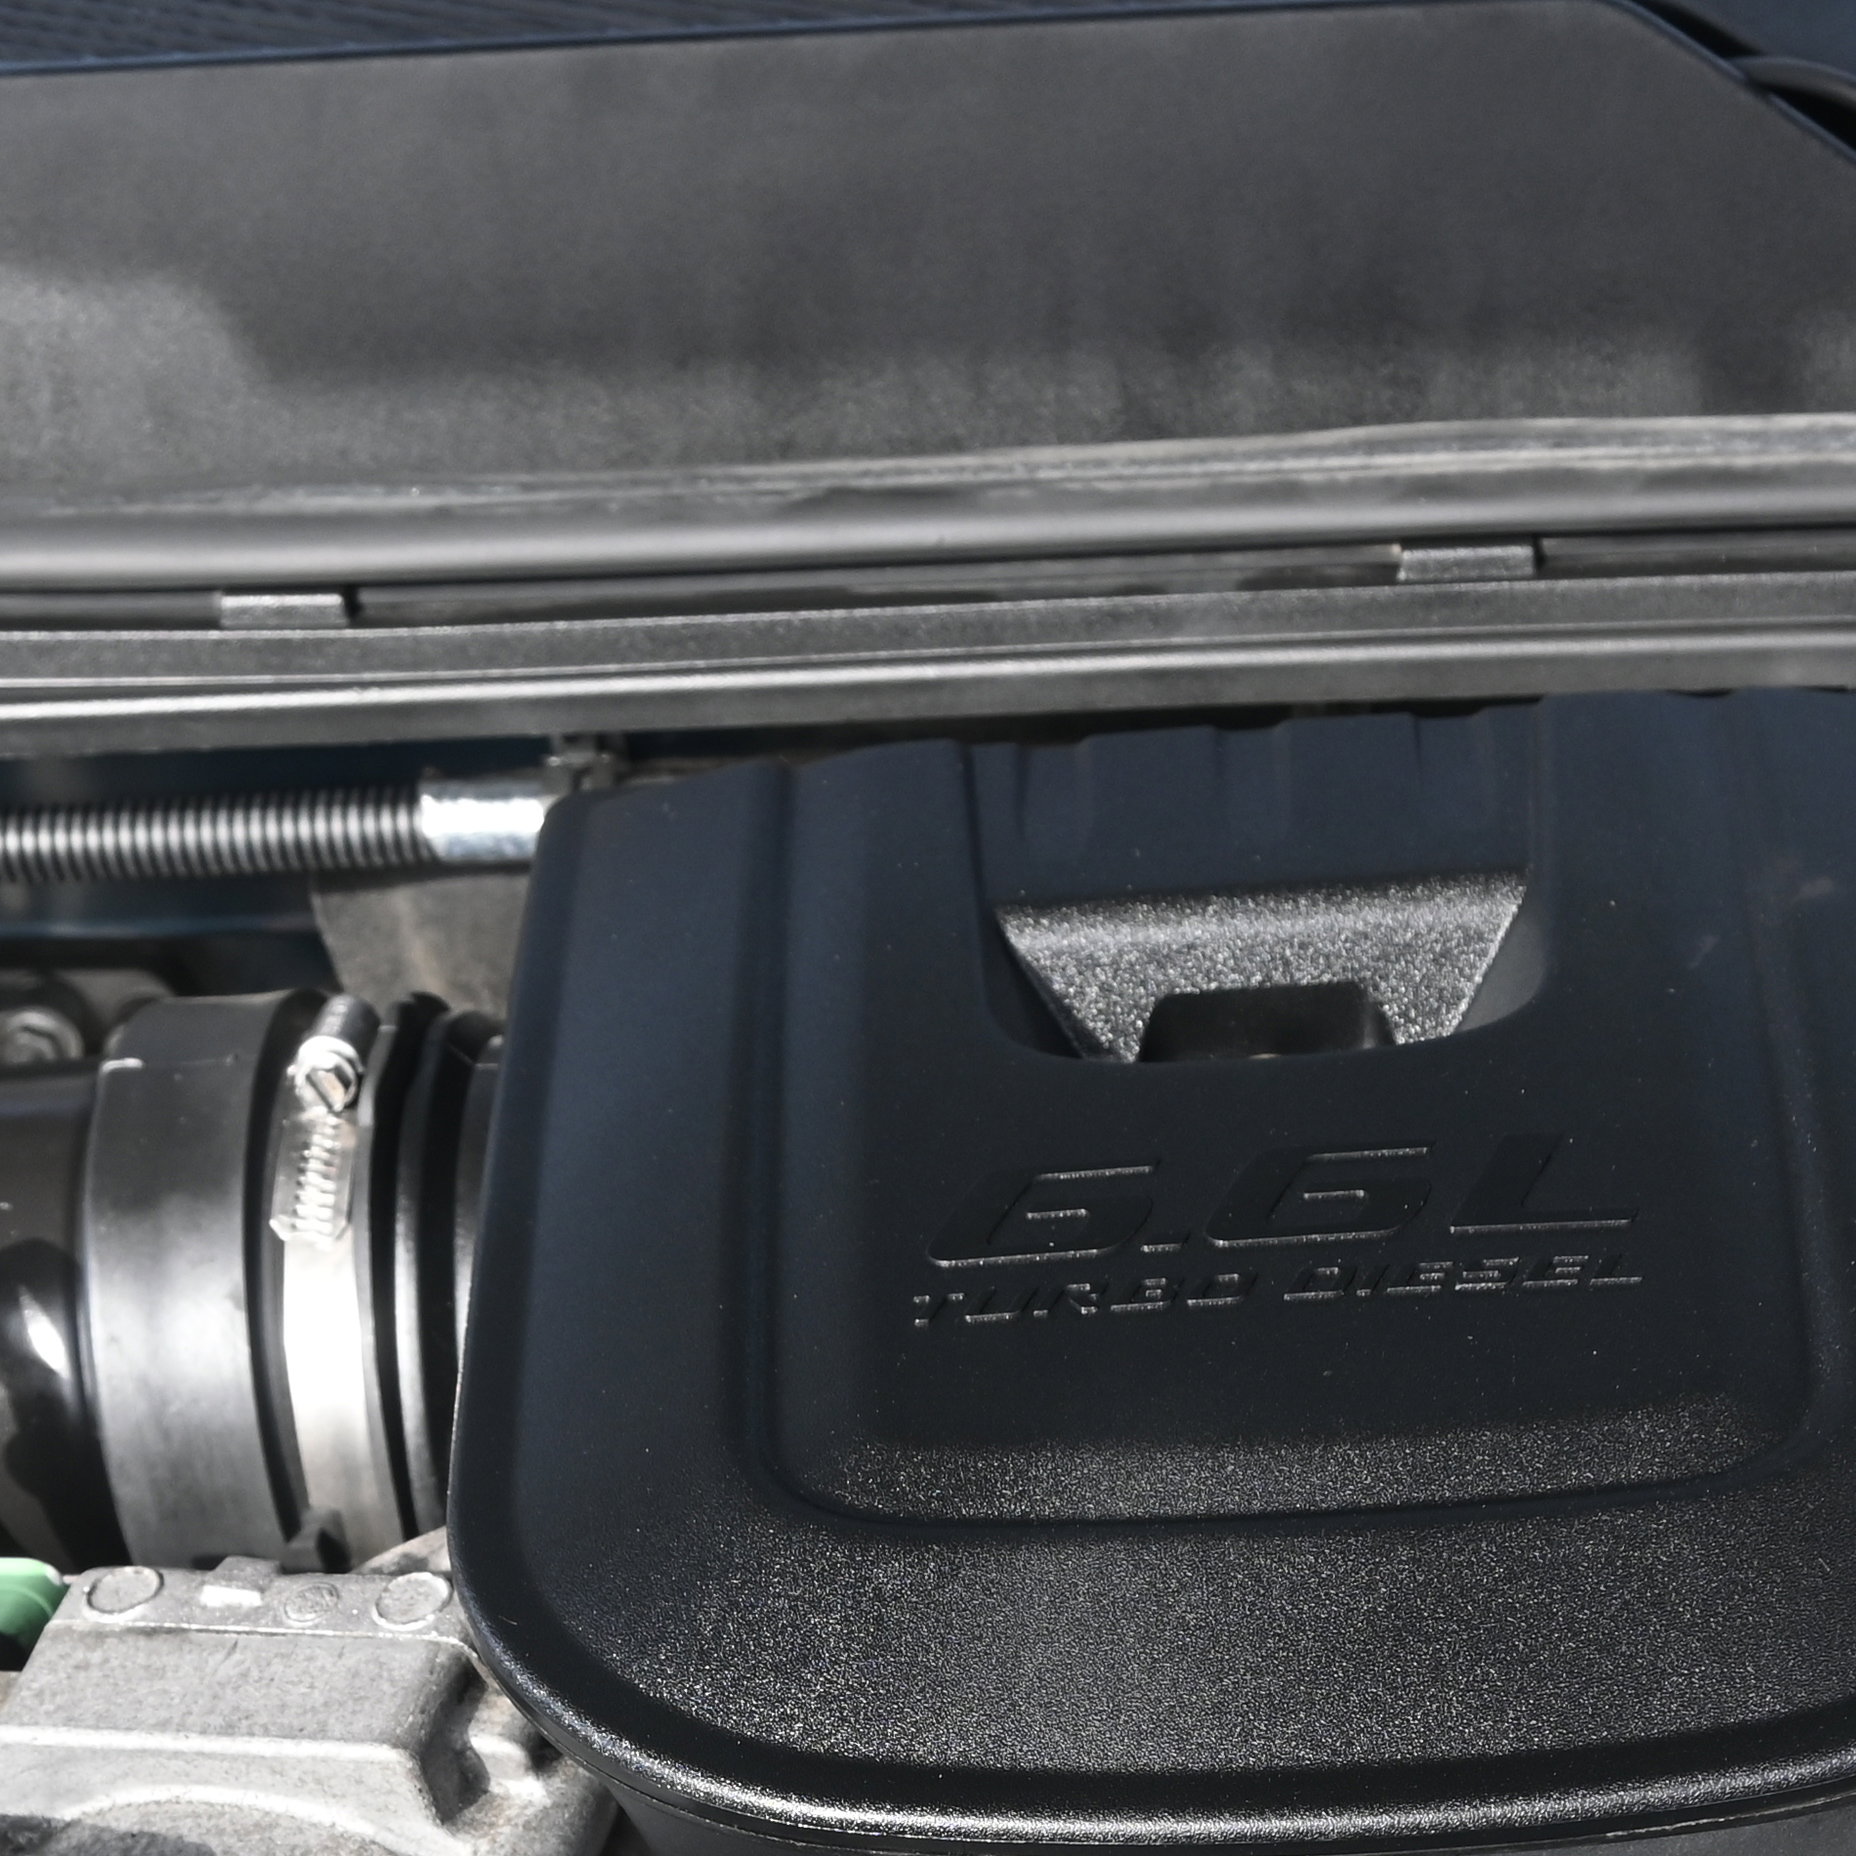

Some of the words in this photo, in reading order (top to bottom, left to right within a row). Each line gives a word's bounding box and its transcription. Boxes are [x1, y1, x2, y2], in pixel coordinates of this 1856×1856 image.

[926, 1133, 1641, 1267] 6.6L
[911, 1270, 1258, 1329] TURBO
[1281, 1251, 1646, 1304] DIESEL
